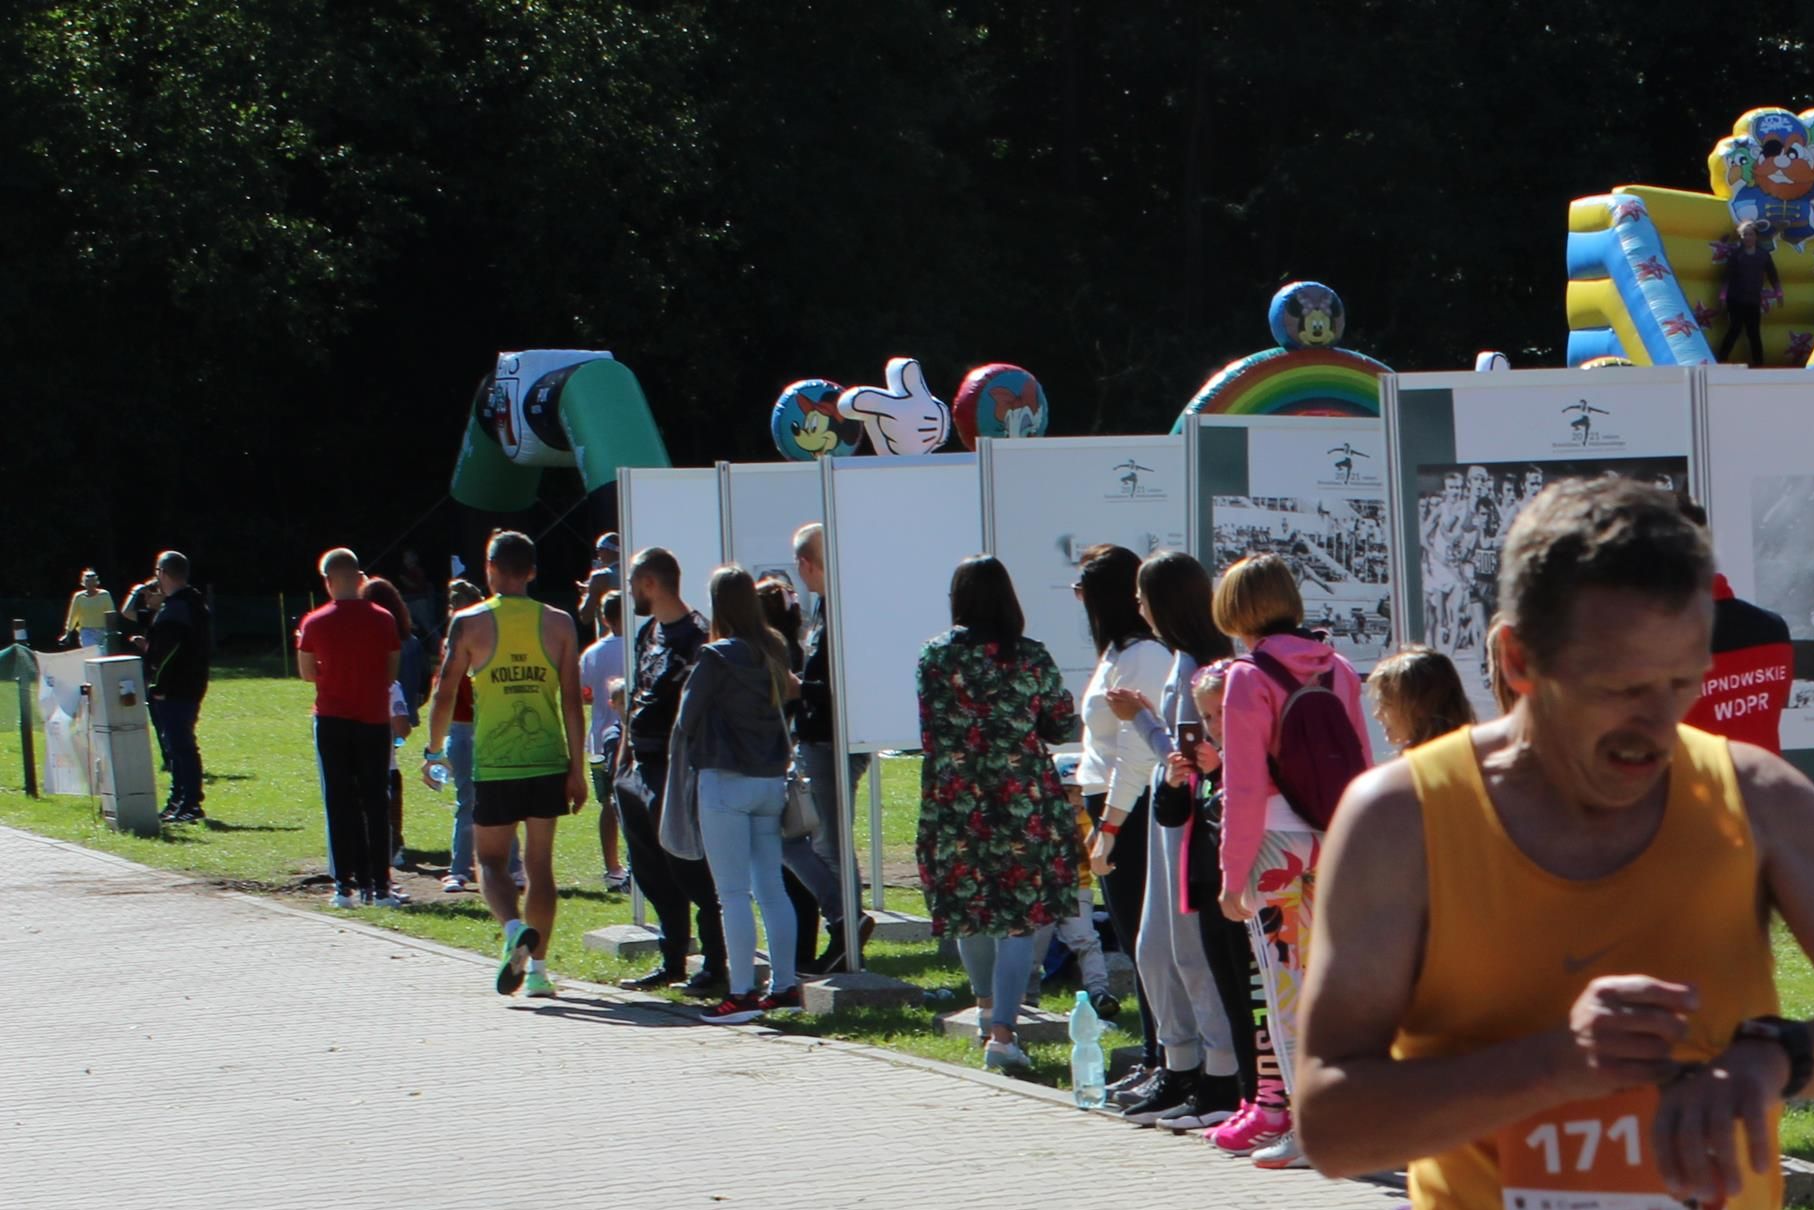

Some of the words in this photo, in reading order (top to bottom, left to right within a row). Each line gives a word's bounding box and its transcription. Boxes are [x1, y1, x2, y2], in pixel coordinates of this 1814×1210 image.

[490, 665, 547, 684] KOLEJARZ
[1701, 665, 1787, 697] IPNOWSKIE
[1714, 693, 1770, 721] WOPR
[1525, 1114, 1642, 1175] 171
